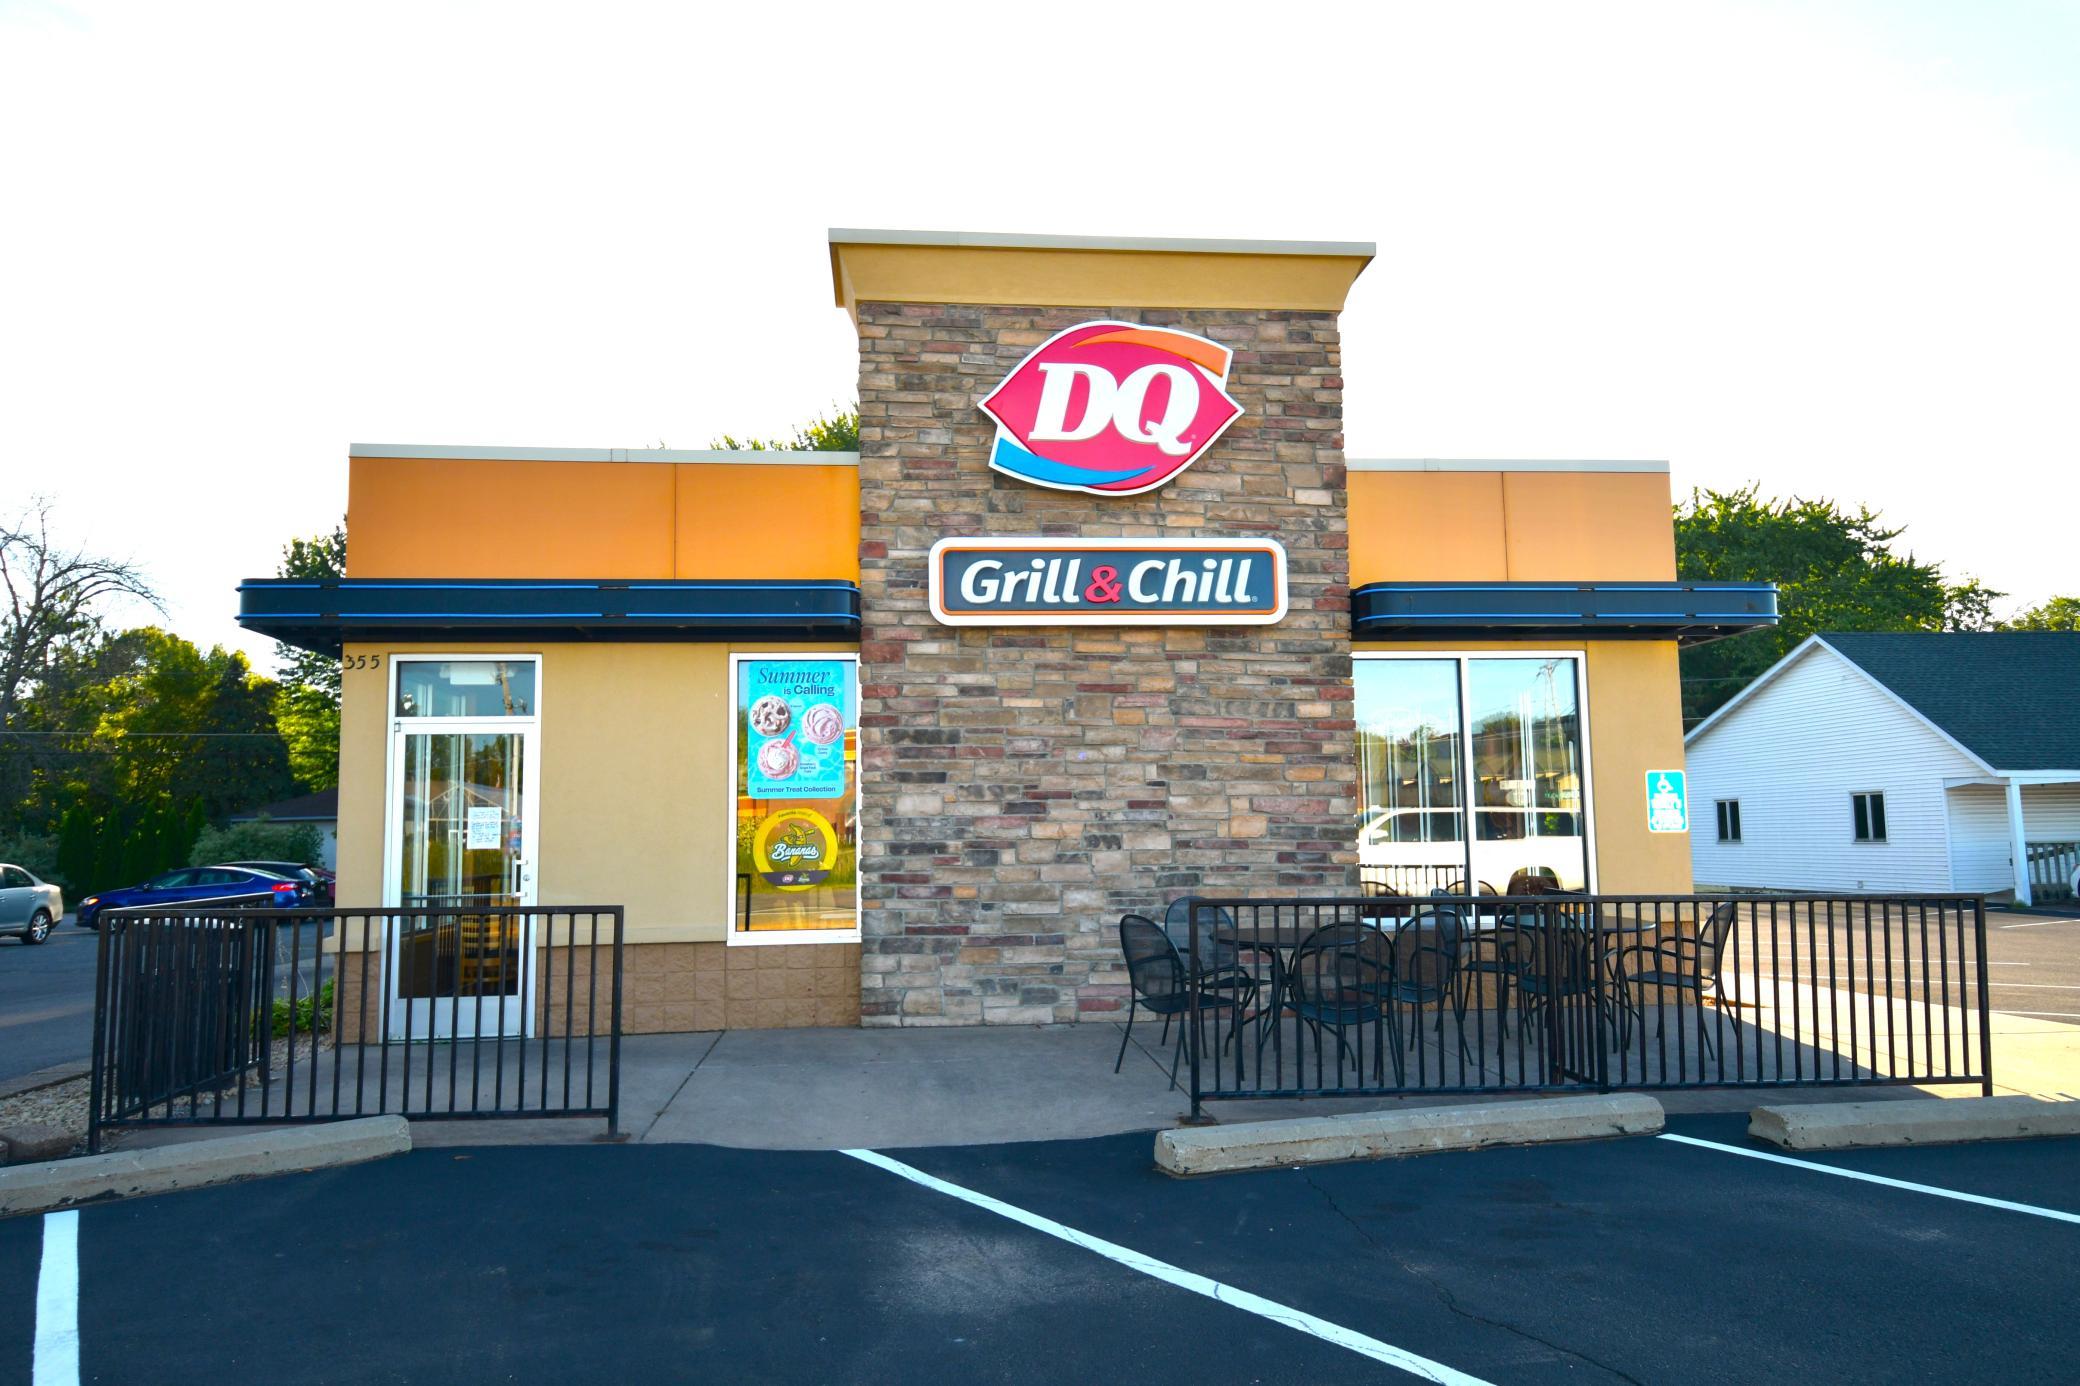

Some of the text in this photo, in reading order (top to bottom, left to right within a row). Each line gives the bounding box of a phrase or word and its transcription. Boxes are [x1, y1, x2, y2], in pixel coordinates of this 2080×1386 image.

[1027, 361, 1201, 456] DQ
[960, 558, 1252, 604] Grill & Chill
[344, 654, 380, 670] 355
[757, 666, 831, 684] Summer
[793, 684, 835, 697] Calling
[771, 842, 820, 862] Bananas
